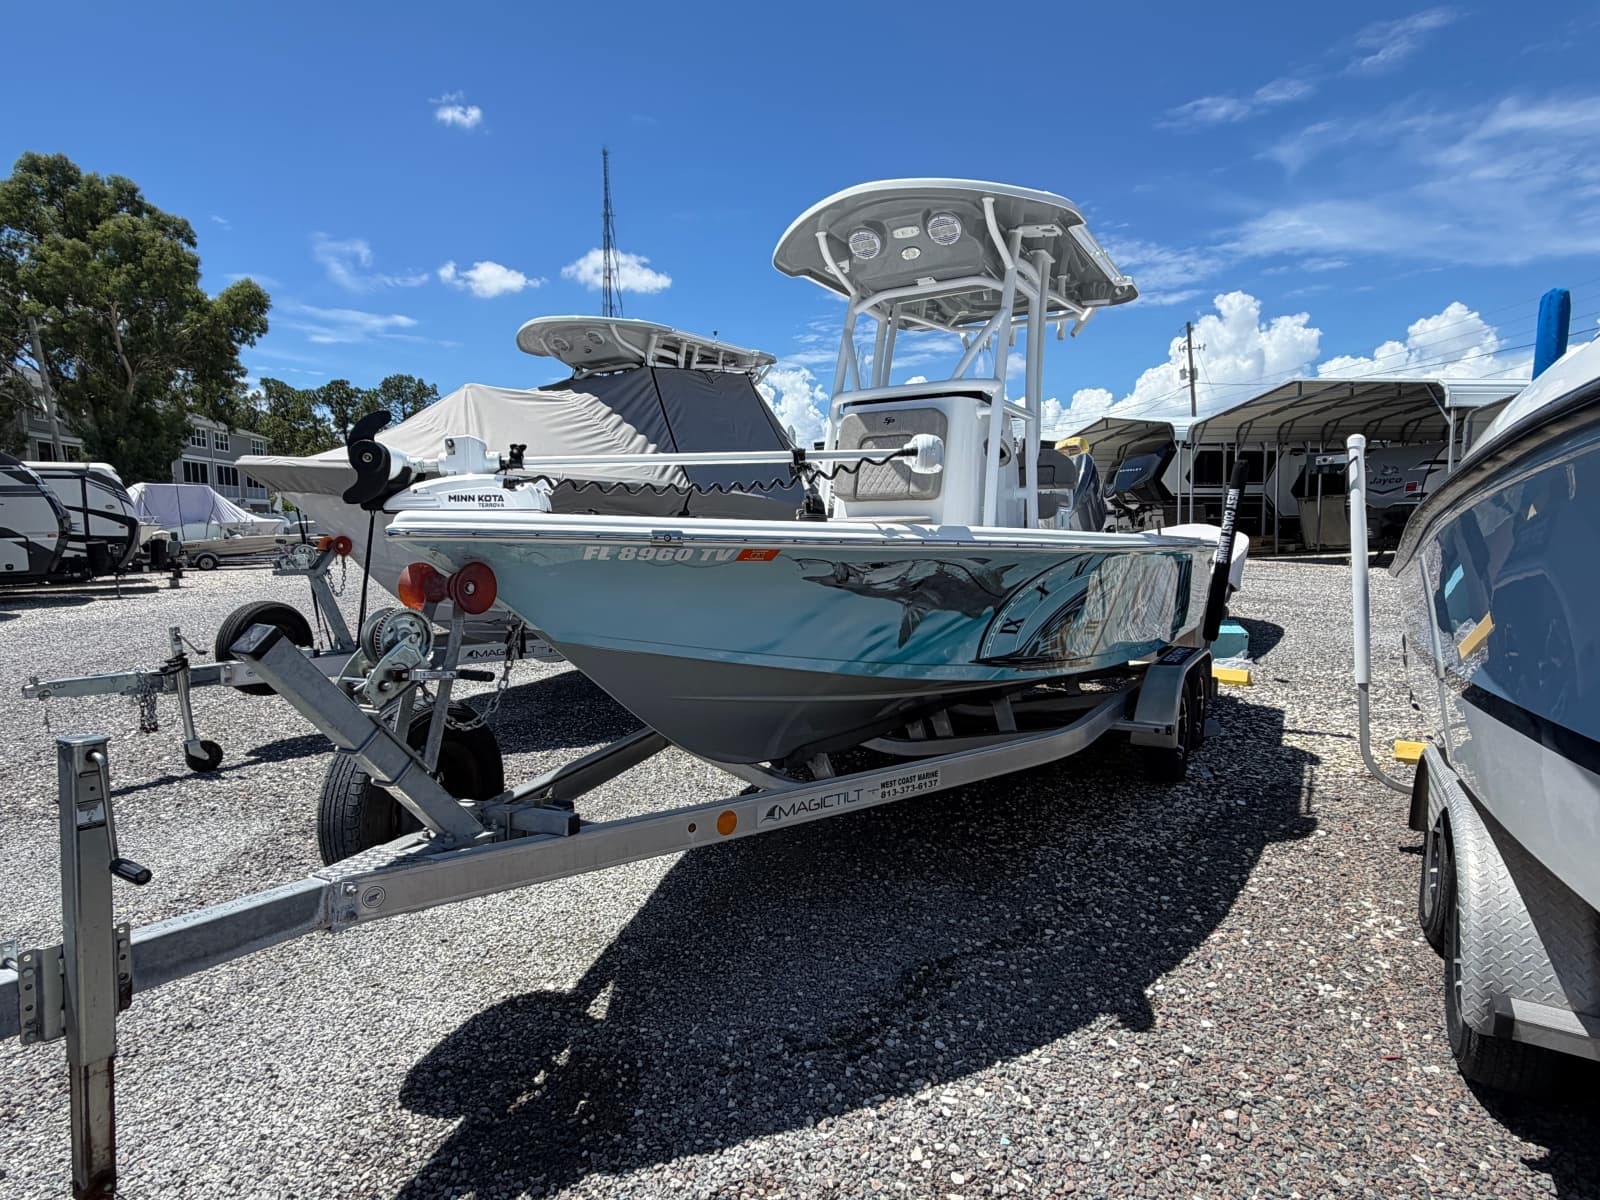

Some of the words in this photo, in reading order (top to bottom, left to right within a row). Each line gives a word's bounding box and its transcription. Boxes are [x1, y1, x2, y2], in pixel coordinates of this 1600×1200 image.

[1369, 476, 1403, 486] Jayco
[448, 494, 475, 503] MINN
[477, 494, 505, 503] KOTA
[1226, 488, 1240, 510] WEST
[1221, 510, 1236, 536] COAST
[583, 546, 611, 561] FL
[617, 546, 695, 562] 8960
[700, 546, 736, 561] TV
[1216, 535, 1231, 564] MARINE
[880, 779, 897, 790] WEST
[897, 774, 916, 786] COAST
[917, 769, 940, 781] MARINE
[880, 778, 939, 799] 813-373-6137
[777, 788, 863, 820] MAGICTILT
